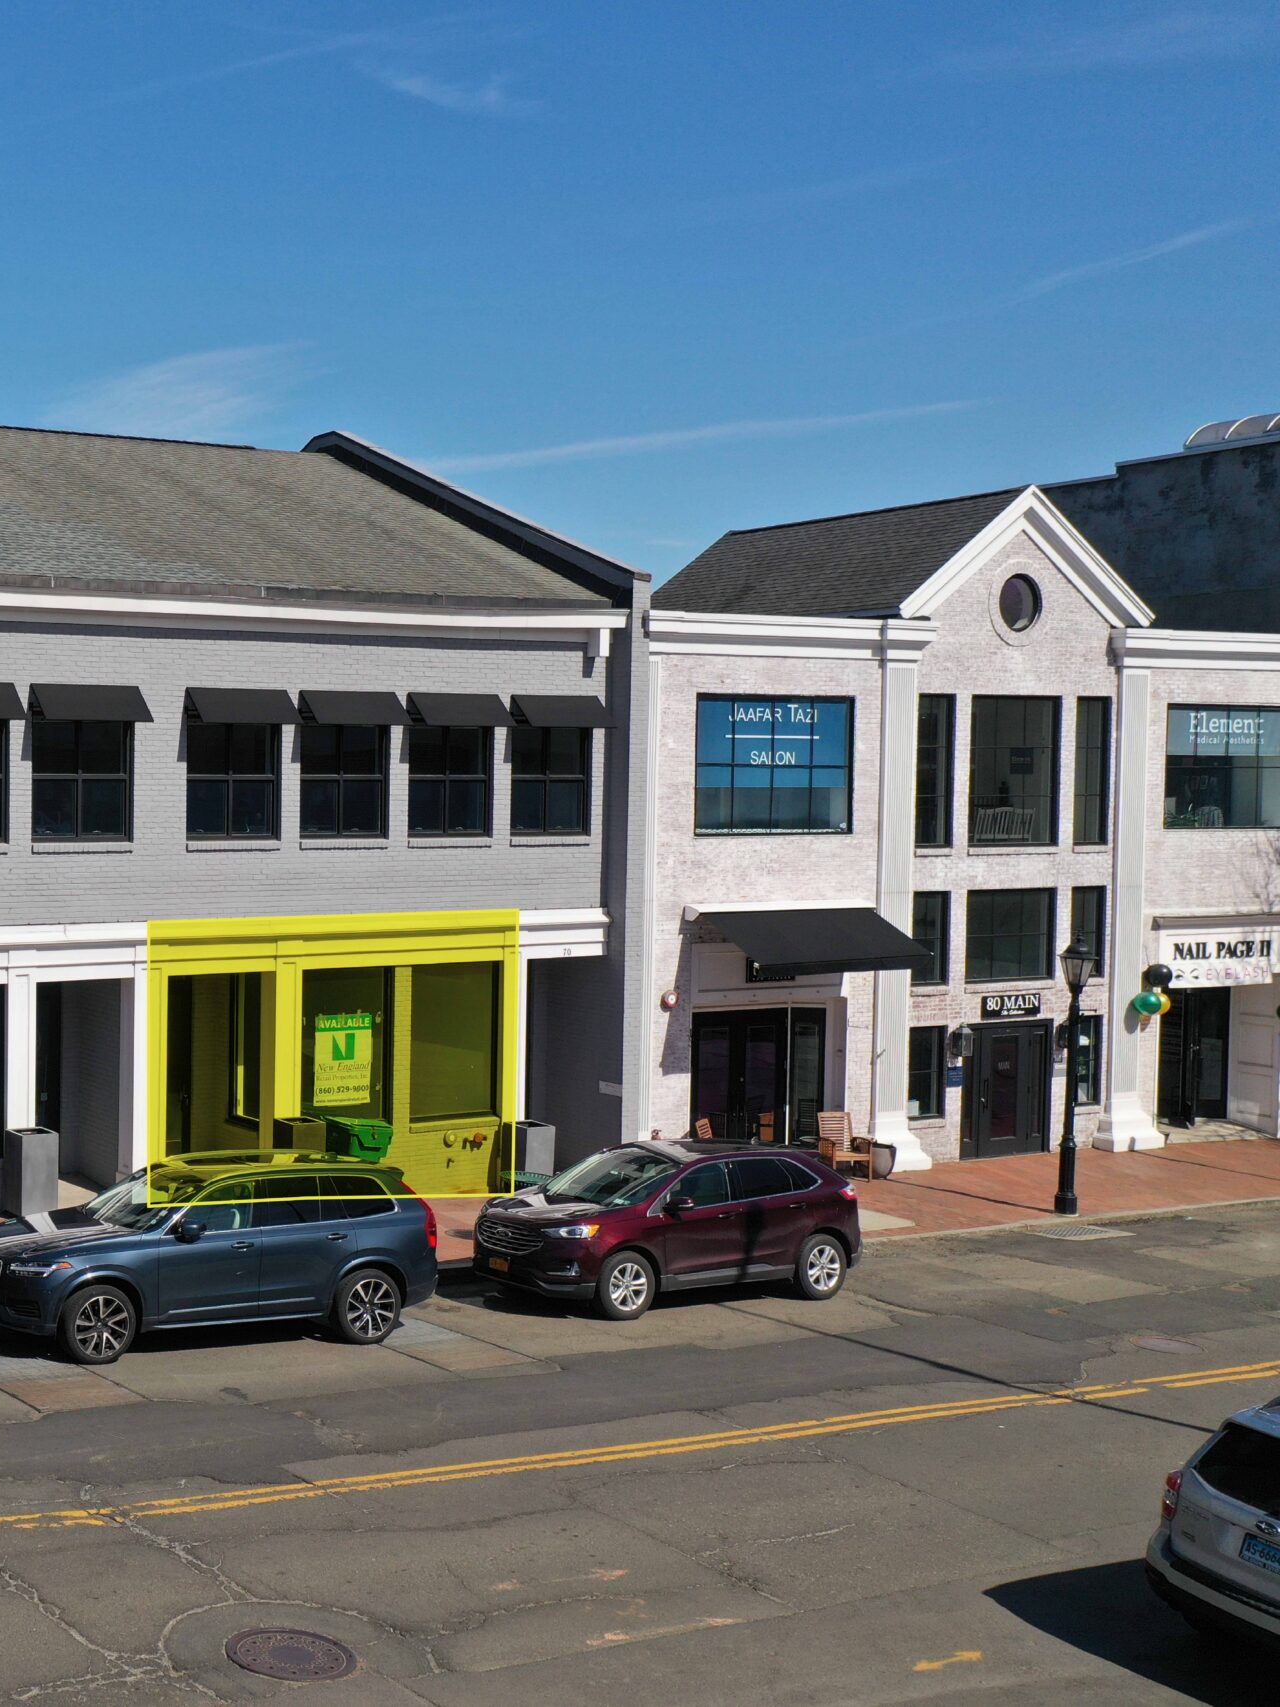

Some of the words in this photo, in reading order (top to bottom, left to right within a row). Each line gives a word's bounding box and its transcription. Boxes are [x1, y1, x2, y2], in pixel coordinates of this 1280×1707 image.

[728, 703, 783, 722] JAAFAR
[787, 704, 818, 723] TAZI
[1189, 712, 1265, 734] Element
[750, 751, 796, 765] SALON
[1172, 941, 1212, 960] NAIL
[1215, 940, 1256, 959] PAGE
[1206, 967, 1269, 980] EYELASH
[986, 996, 1001, 1011] 80
[1003, 994, 1040, 1010] MAIN
[315, 1063, 334, 1073] New
[336, 1060, 370, 1072] England
[315, 1087, 335, 1096] (860)
